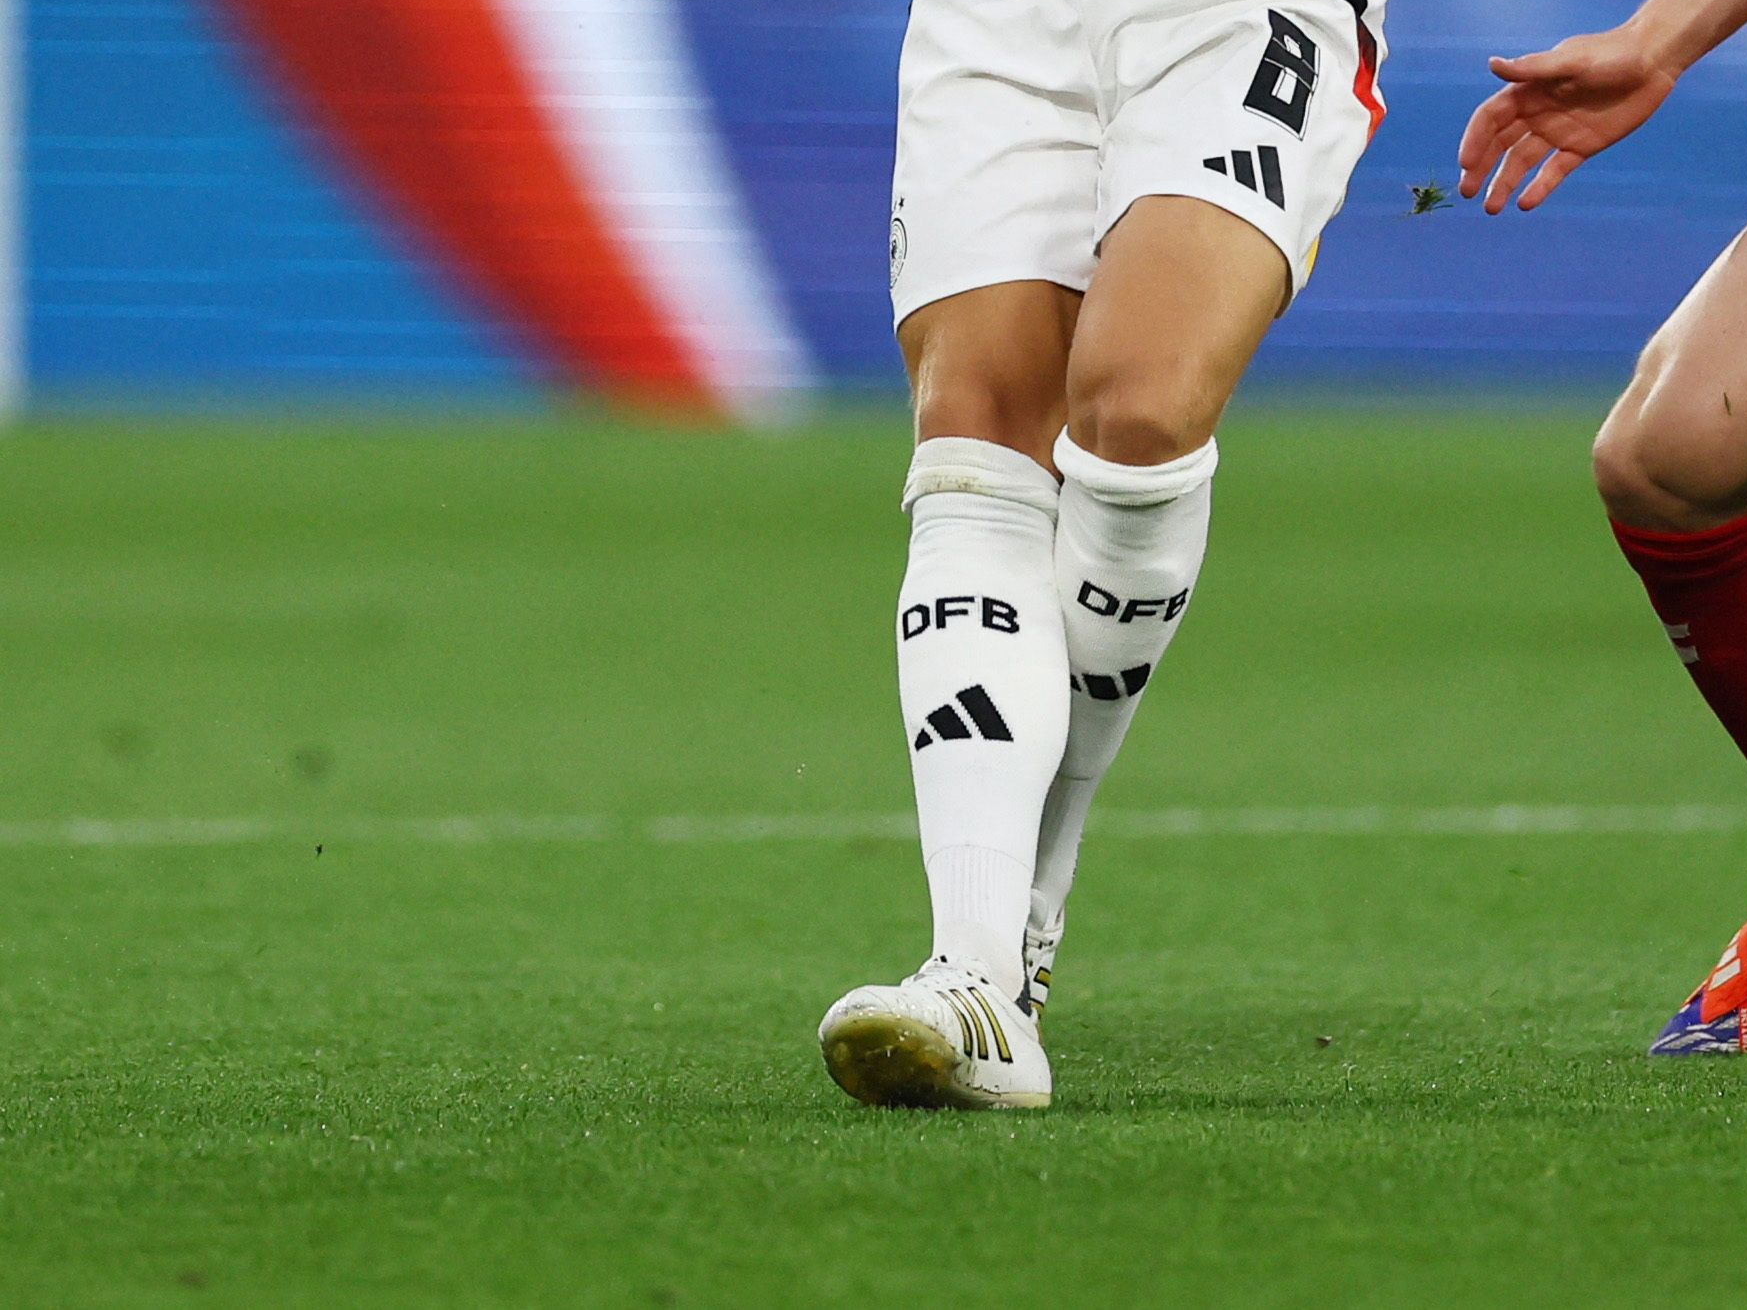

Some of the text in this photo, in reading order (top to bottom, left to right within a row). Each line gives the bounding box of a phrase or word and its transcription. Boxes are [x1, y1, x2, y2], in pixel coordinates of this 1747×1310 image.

[1243, 8, 1320, 142] 8
[902, 596, 1020, 641] DFB
[1077, 580, 1189, 624] DFB
